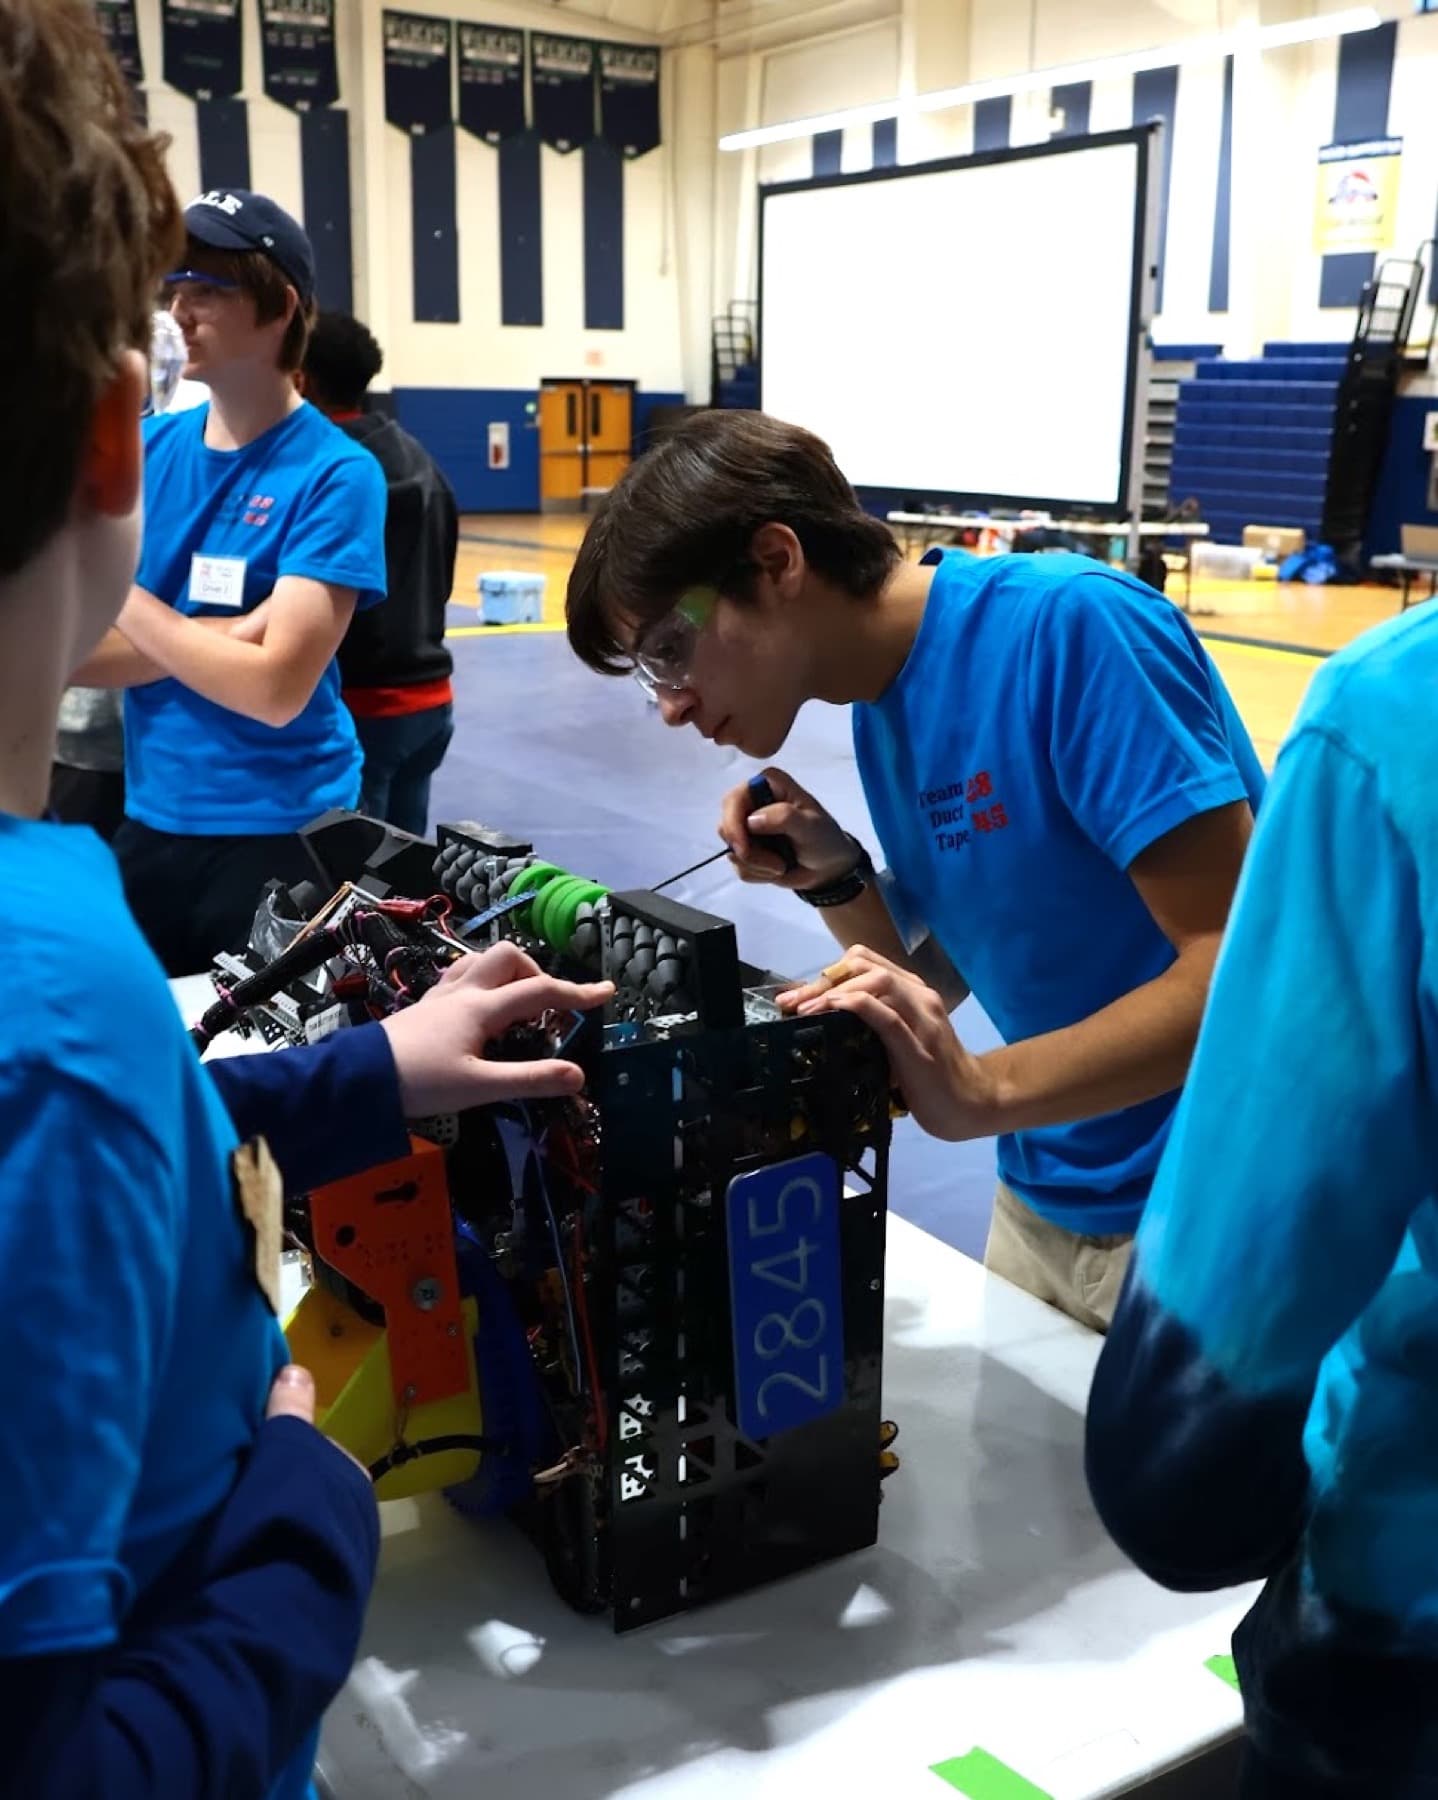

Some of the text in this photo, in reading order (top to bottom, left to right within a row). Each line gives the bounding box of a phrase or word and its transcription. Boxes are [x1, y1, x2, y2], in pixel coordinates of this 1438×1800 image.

[919, 782, 963, 808] Team
[929, 804, 964, 829] Duct
[936, 830, 970, 851] Tape
[749, 1177, 827, 1416] 2845
